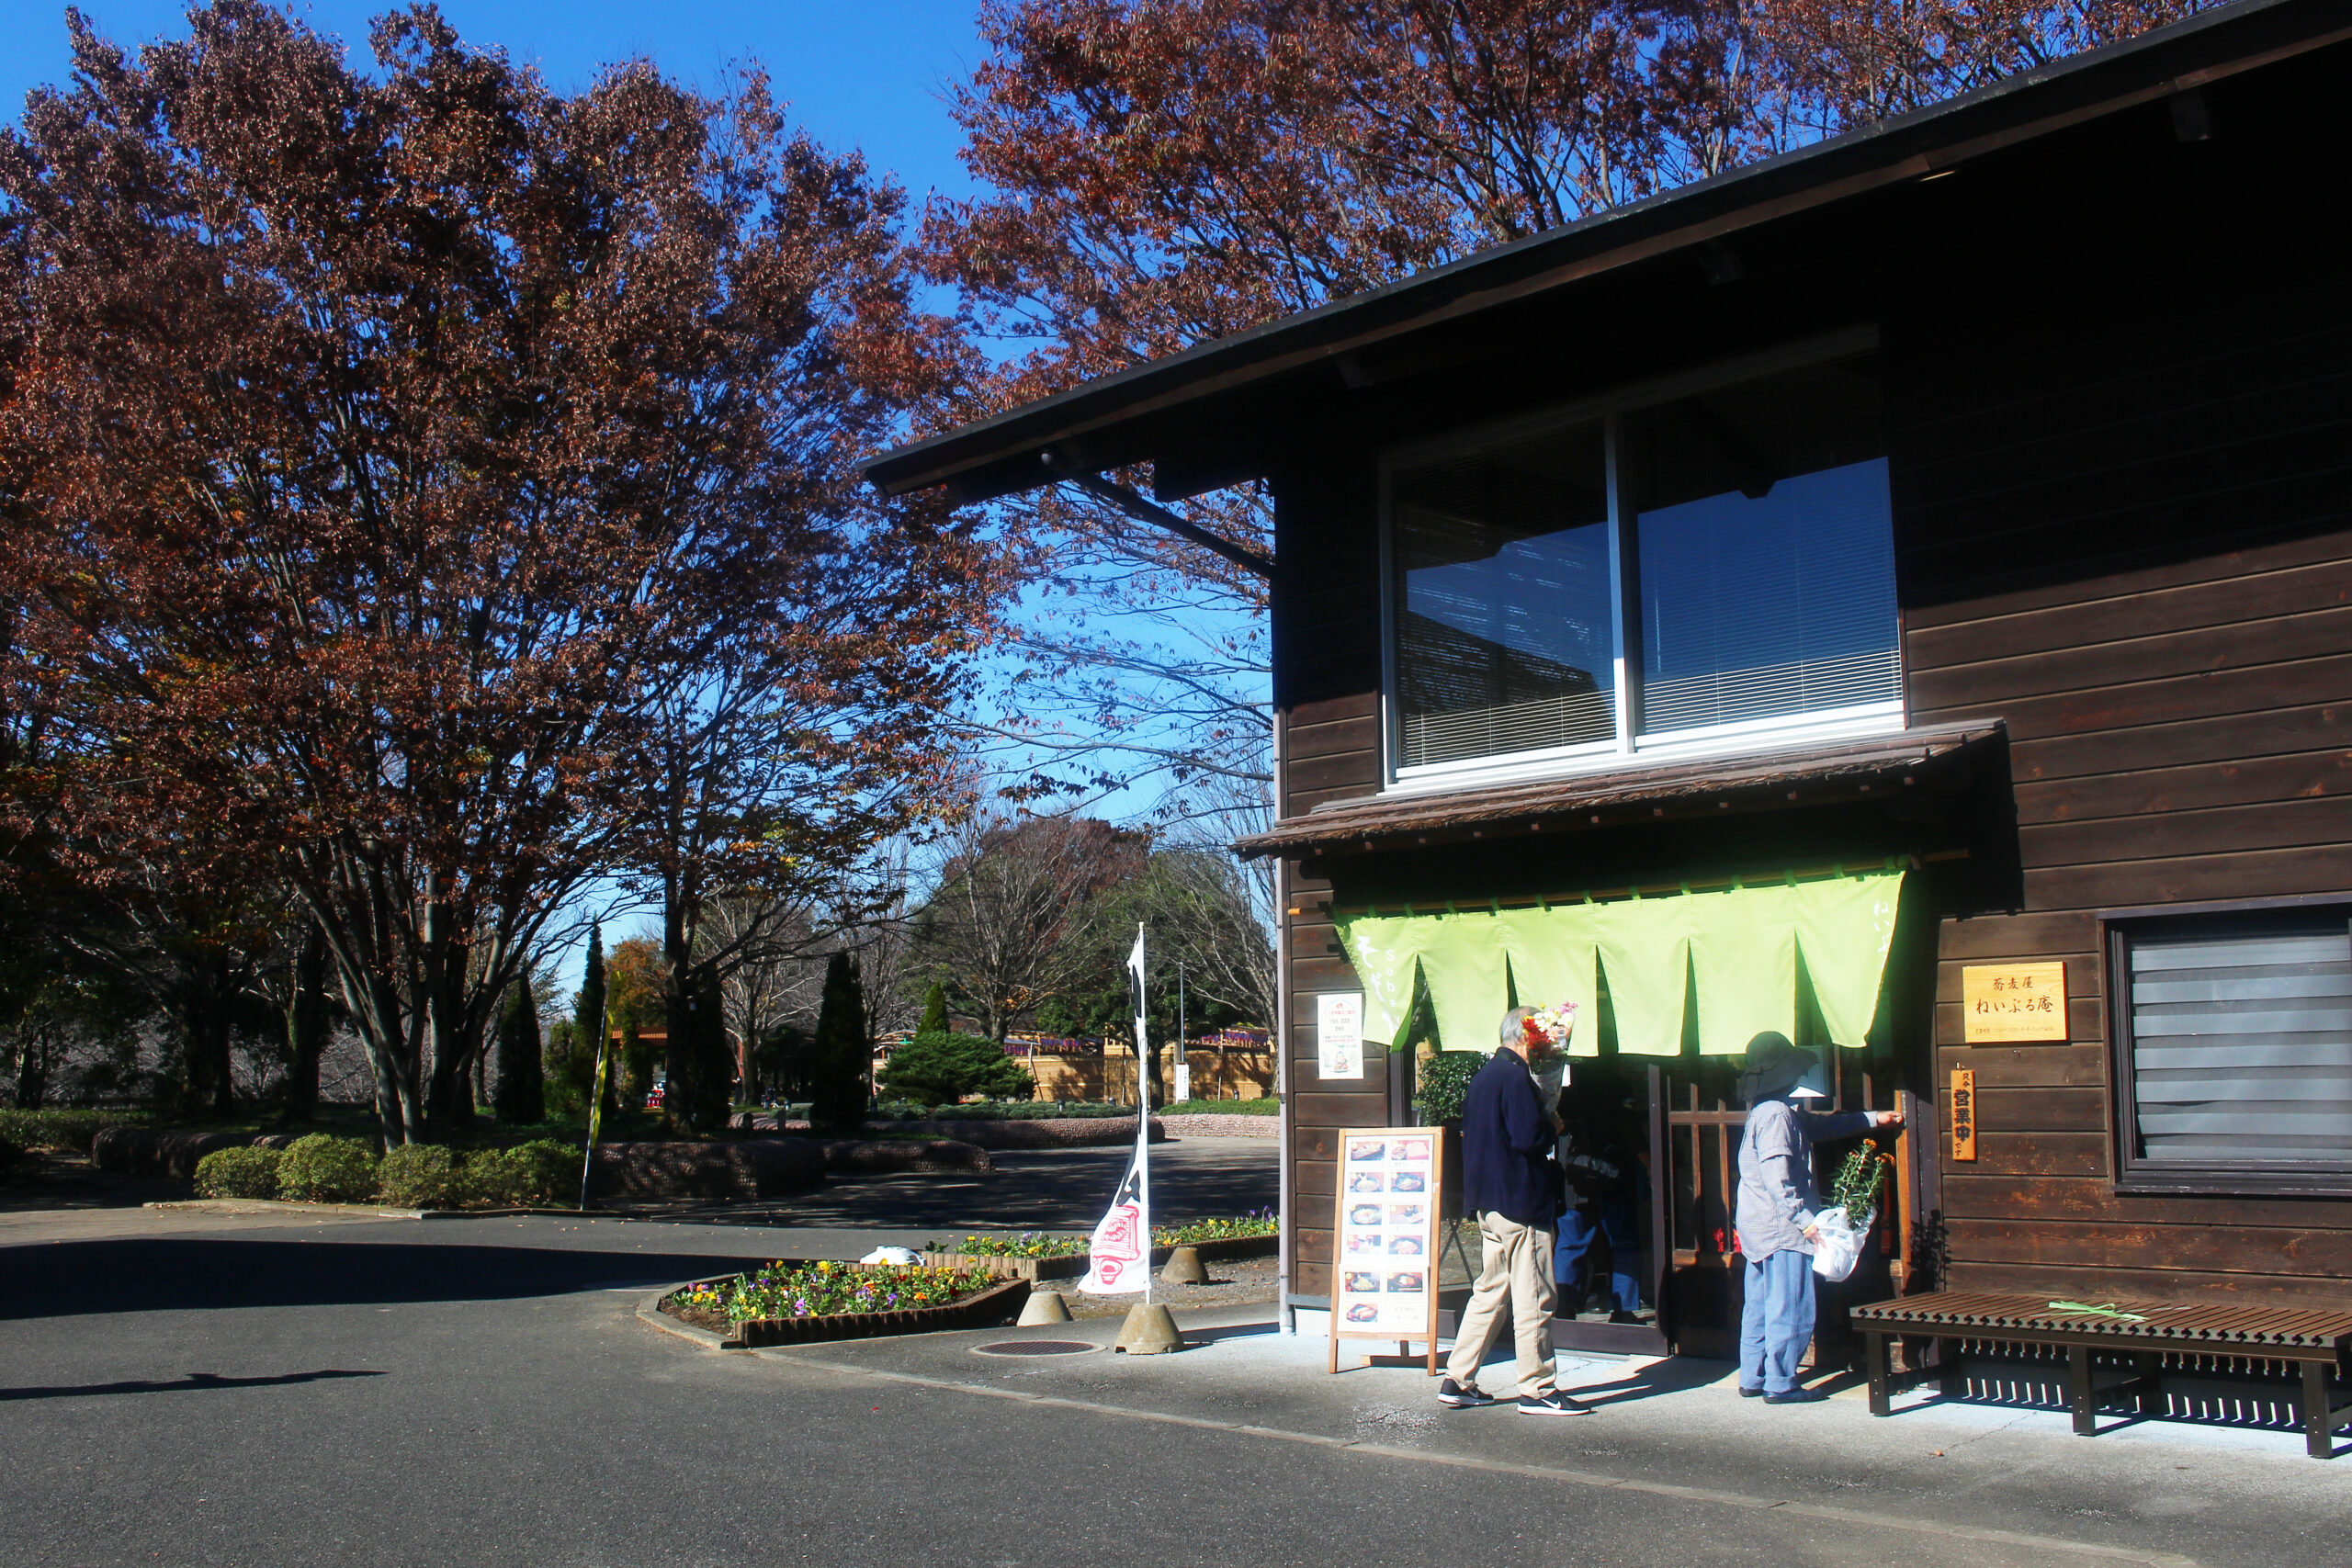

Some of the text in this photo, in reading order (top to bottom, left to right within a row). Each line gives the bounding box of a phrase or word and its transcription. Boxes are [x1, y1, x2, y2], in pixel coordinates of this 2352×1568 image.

[1992, 976, 2034, 991] 蕎麦屋
[1975, 995, 2054, 1015] ねいぶる庵
[1953, 1089, 1972, 1143] 営業中
